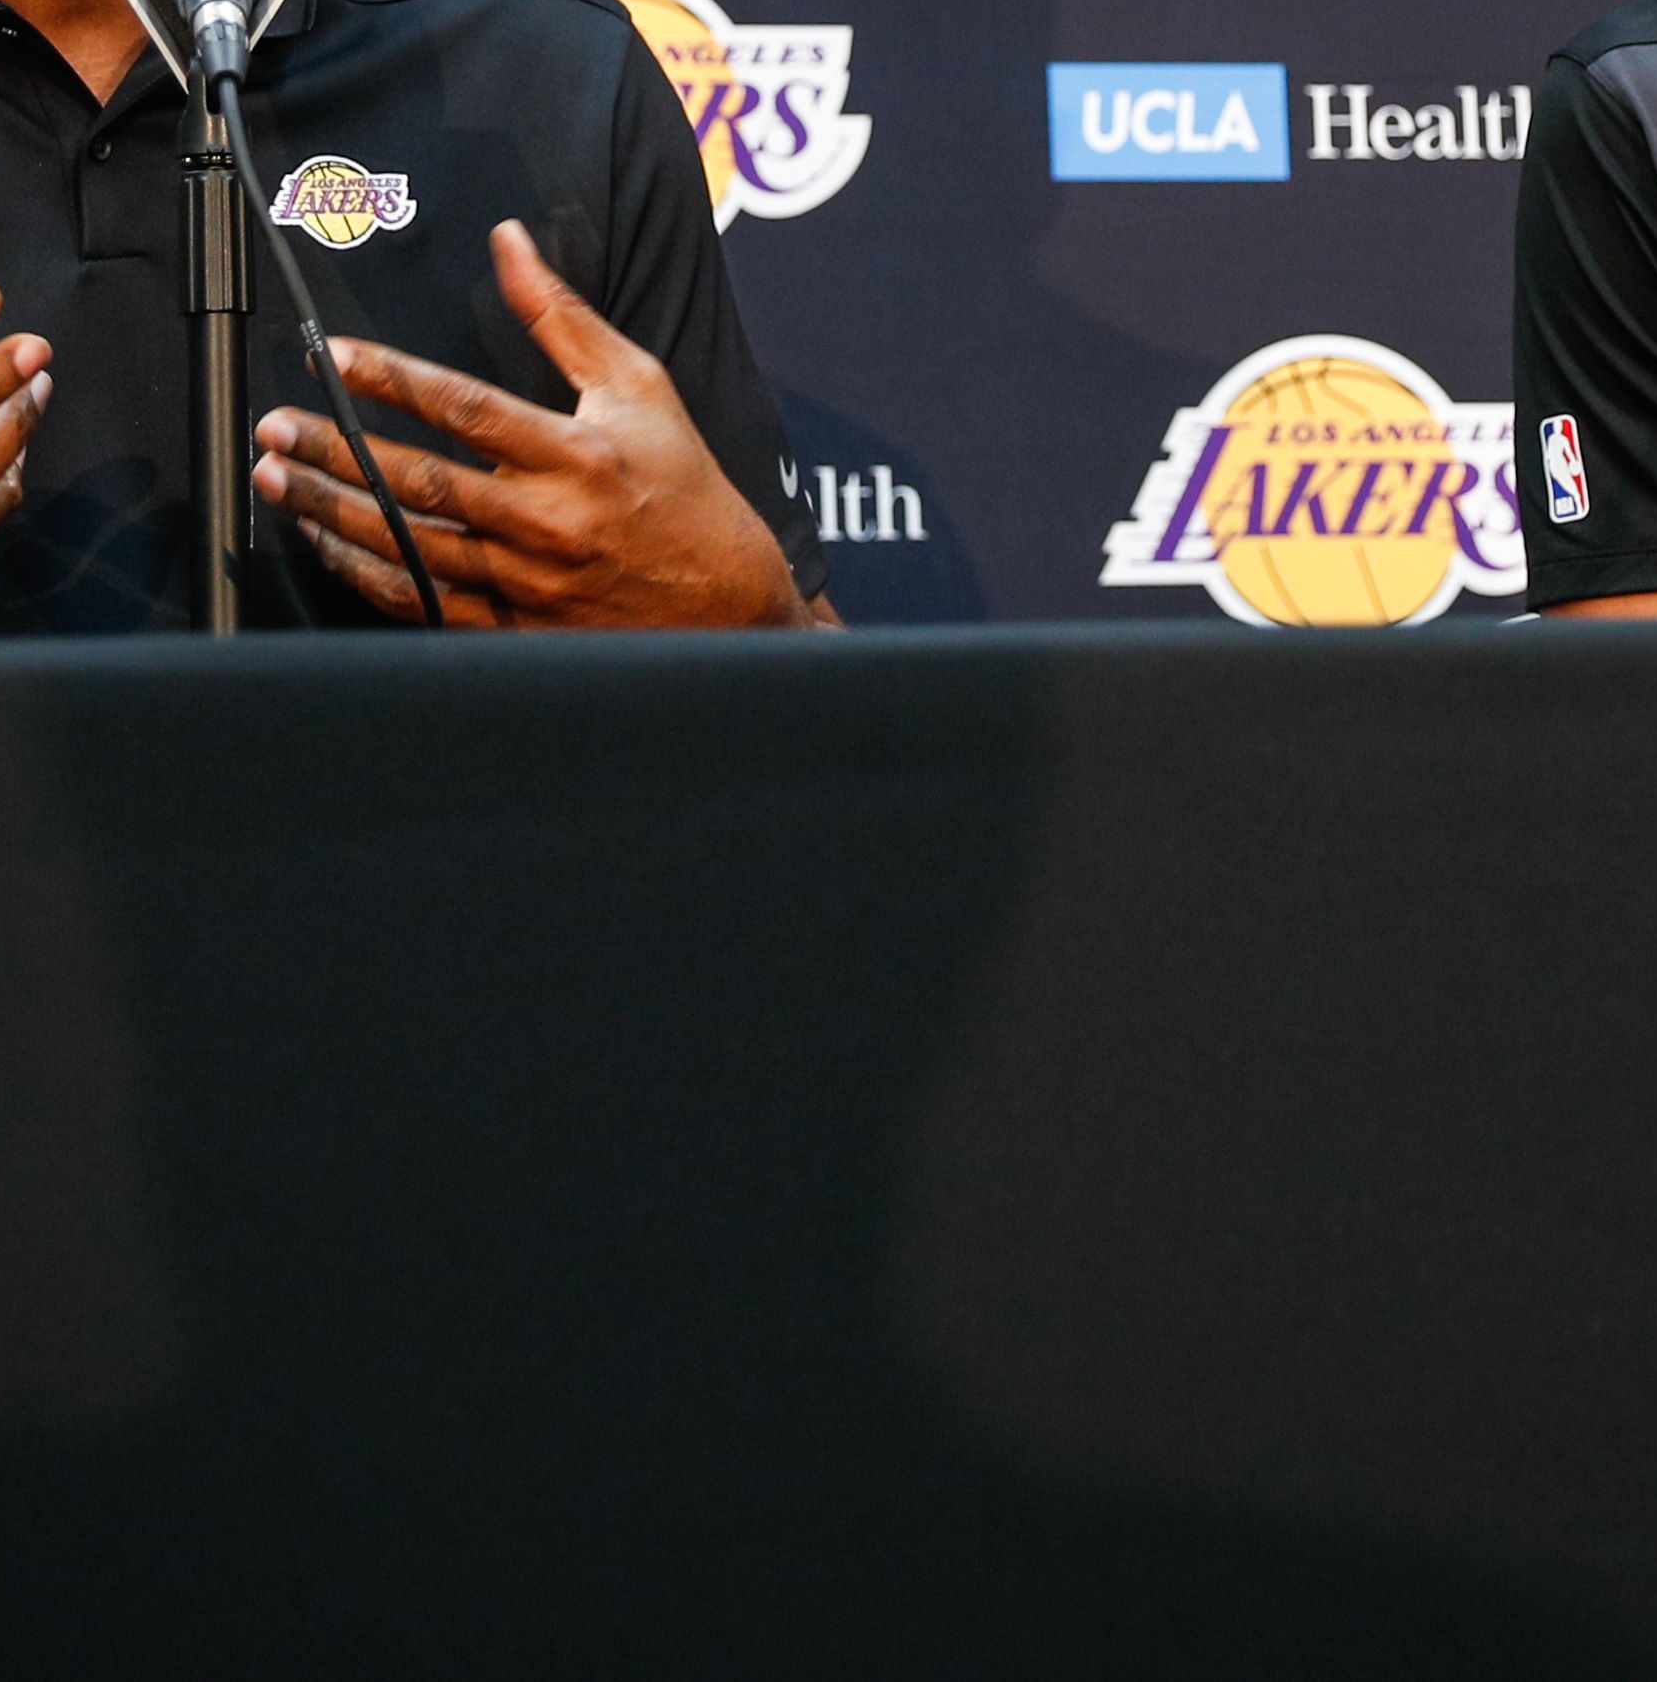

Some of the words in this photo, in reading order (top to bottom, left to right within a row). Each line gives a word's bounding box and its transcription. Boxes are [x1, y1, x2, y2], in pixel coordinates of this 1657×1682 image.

[666, 42, 826, 63] NGELES
[1081, 87, 1263, 155] UCLA
[311, 178, 334, 188] LOS
[281, 178, 403, 223] LAKERS
[1266, 421, 1337, 444] LOS
[1352, 421, 1514, 442] ANGELE
[813, 464, 929, 543] lth
